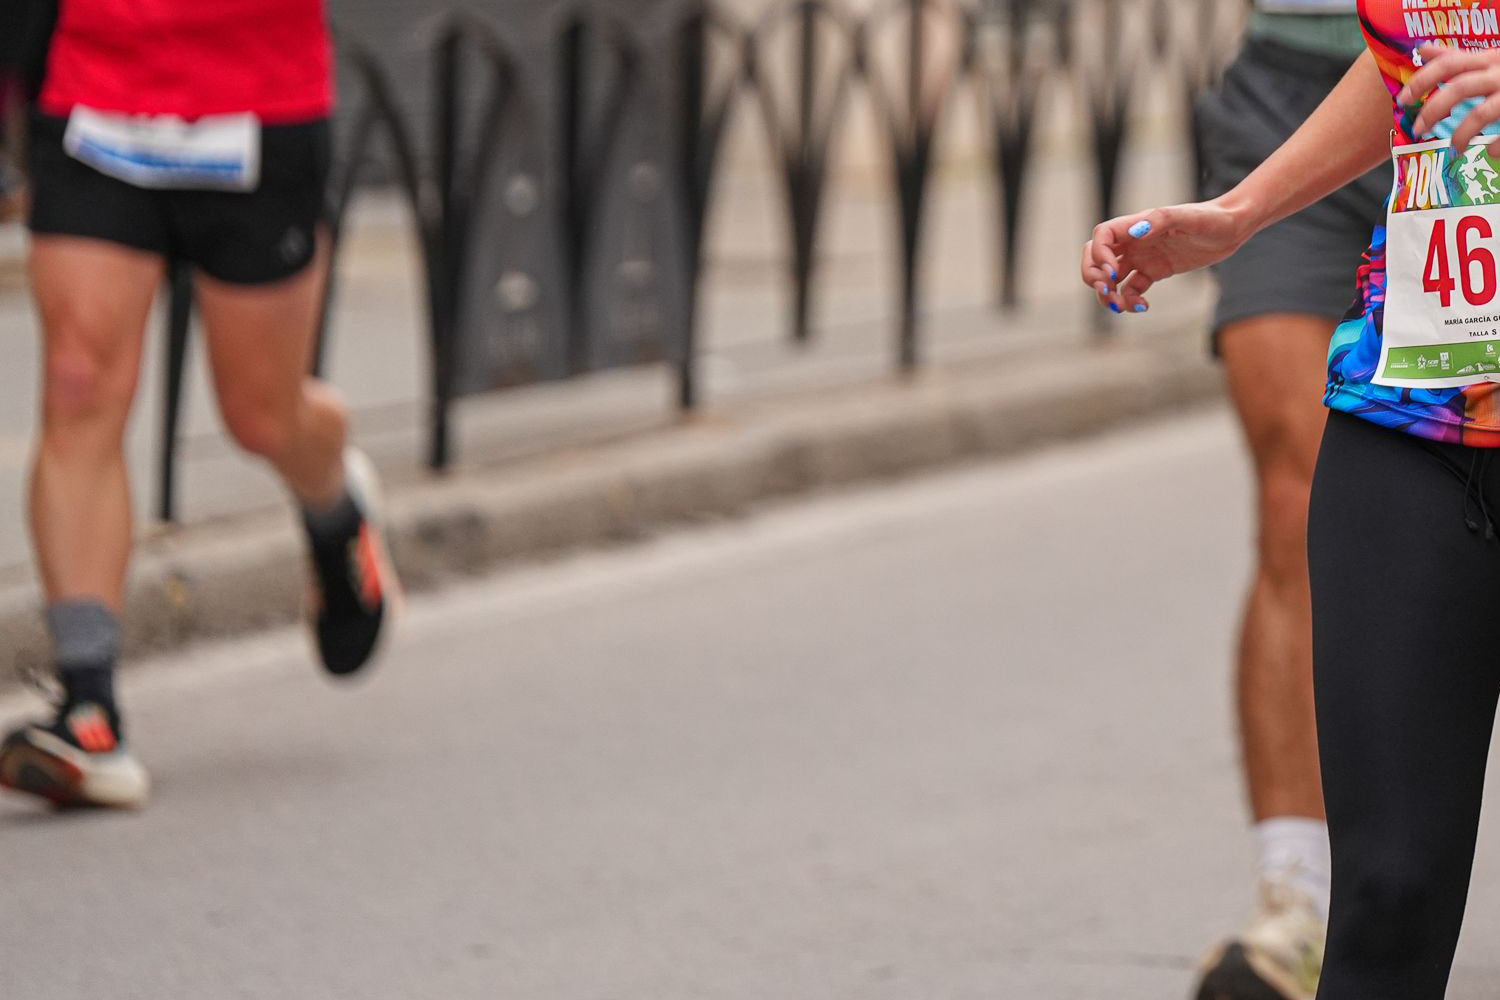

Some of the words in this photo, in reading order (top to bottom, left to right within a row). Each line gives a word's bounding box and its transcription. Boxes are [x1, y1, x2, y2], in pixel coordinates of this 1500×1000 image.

[1403, 2, 1499, 38] MARATÓN
[1462, 38, 1489, 49] Ciudad
[1405, 150, 1448, 209] 10K
[1444, 317, 1463, 326] MARÍA
[1464, 316, 1491, 324] GARCÍA
[1492, 328, 1497, 336] S
